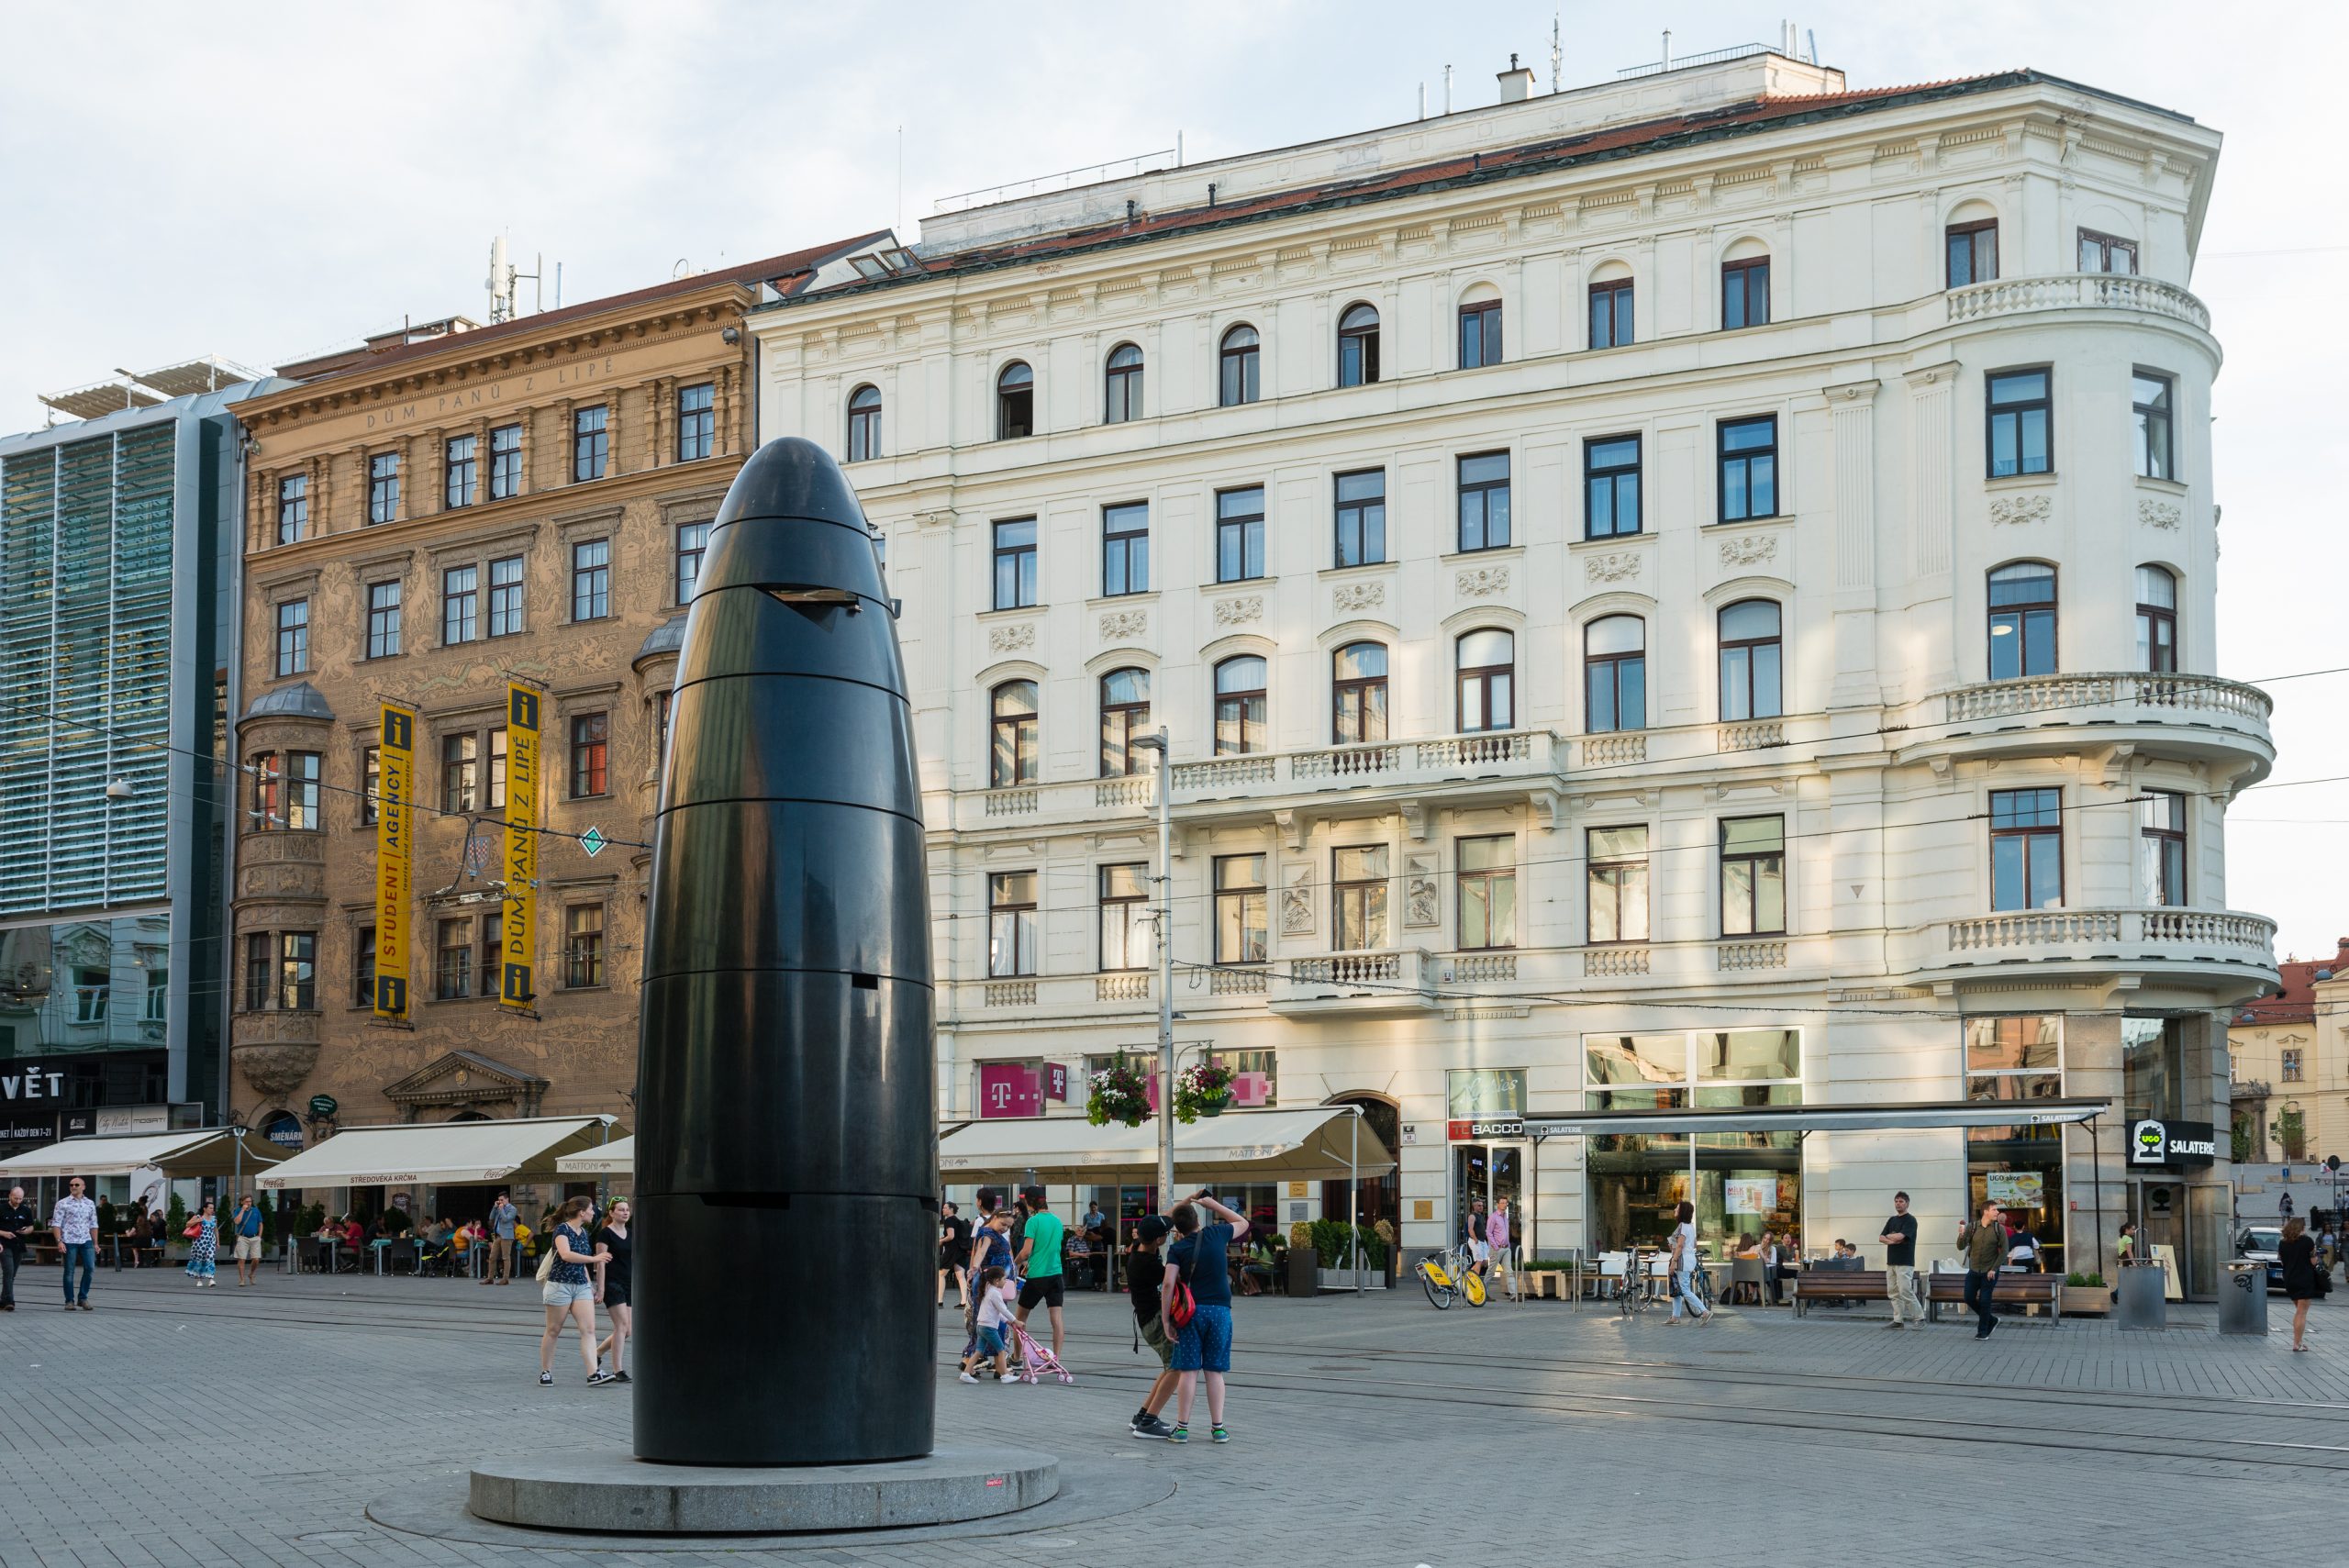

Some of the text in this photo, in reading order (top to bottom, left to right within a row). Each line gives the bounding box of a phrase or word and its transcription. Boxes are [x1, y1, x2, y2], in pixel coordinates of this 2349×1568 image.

[368, 359, 613, 428] DŮM PÁNŮ Z LIPÉ
[513, 736, 530, 784] LIPÉ
[514, 792, 529, 808] Z
[383, 764, 400, 956] STUDENT AGENCY
[1, 1066, 64, 1100] VĚT
[29, 1128, 39, 1137] DEN
[1550, 1126, 1583, 1134] SALATERIE
[2142, 1135, 2160, 1143] UGO
[1229, 1149, 1273, 1159] MATTONI
[2169, 1140, 2215, 1155] SALATERIE
[564, 1162, 598, 1171] MATTONI
[350, 1173, 417, 1184] STŘEDOVĚKÁ KRČMA
